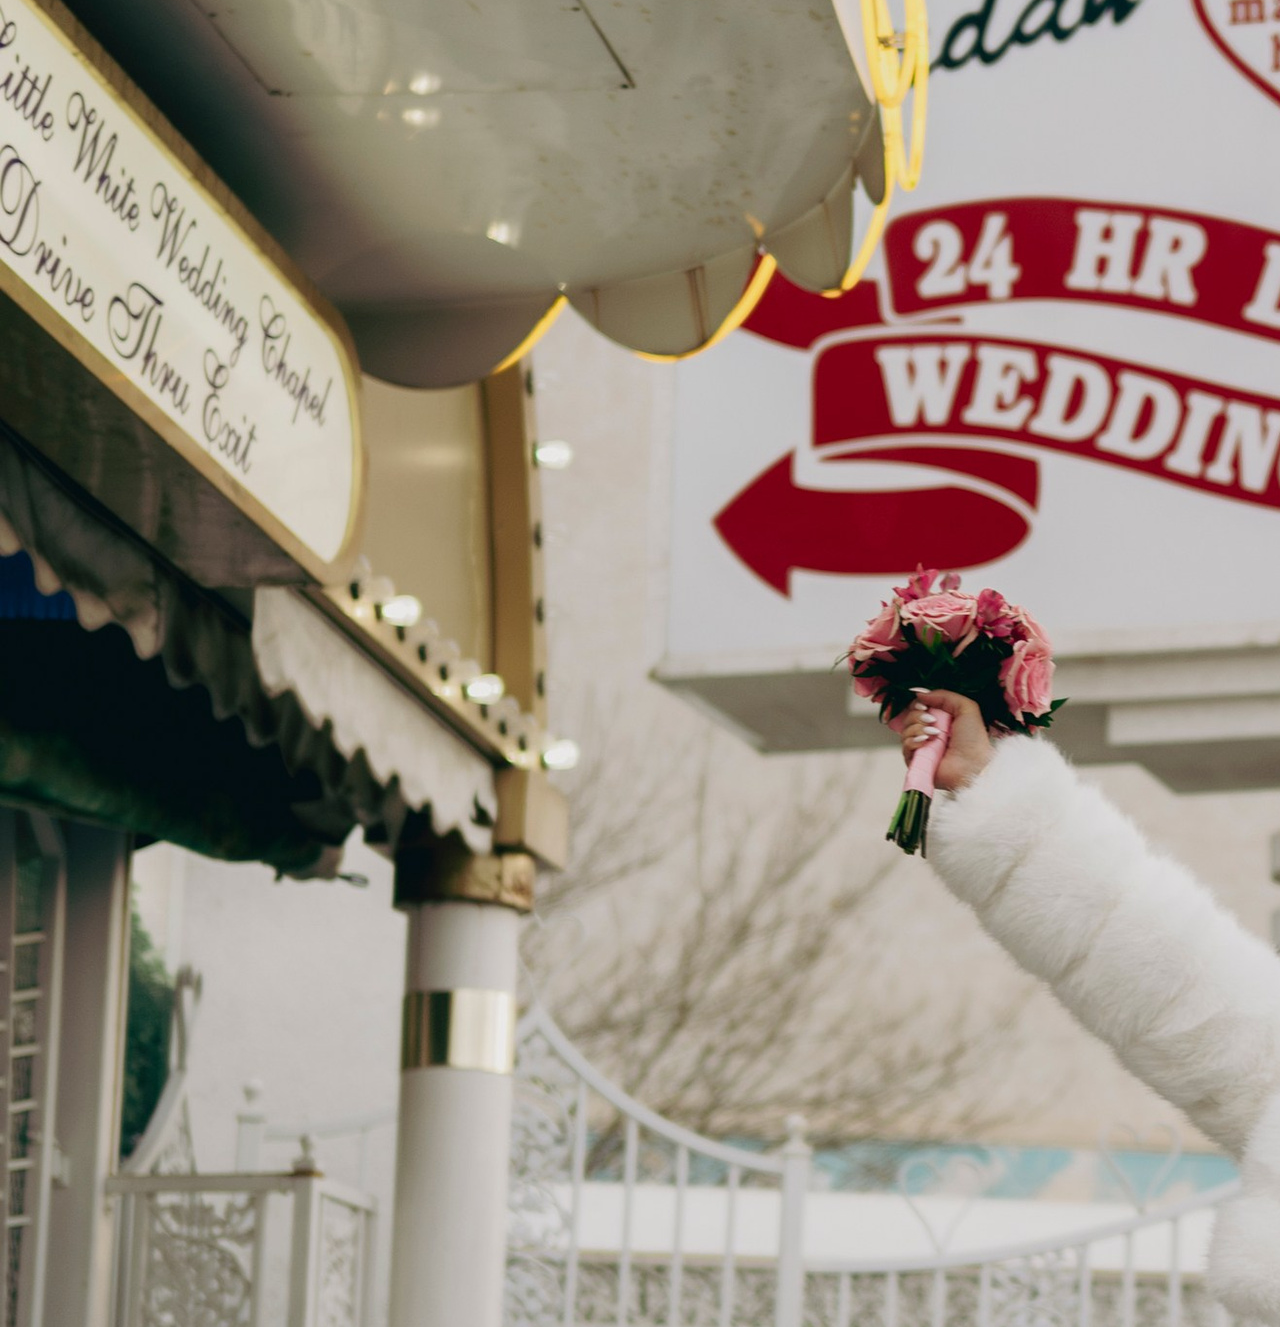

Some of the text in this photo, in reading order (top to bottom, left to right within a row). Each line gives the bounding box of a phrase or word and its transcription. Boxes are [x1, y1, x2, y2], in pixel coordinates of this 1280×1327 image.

[0, 144, 258, 475] Drive Thru Exit
[66, 90, 141, 232] White
[150, 181, 250, 368] Wedding
[258, 293, 334, 426] Chapel
[913, 211, 1022, 301] 24
[1064, 208, 1208, 307] HR
